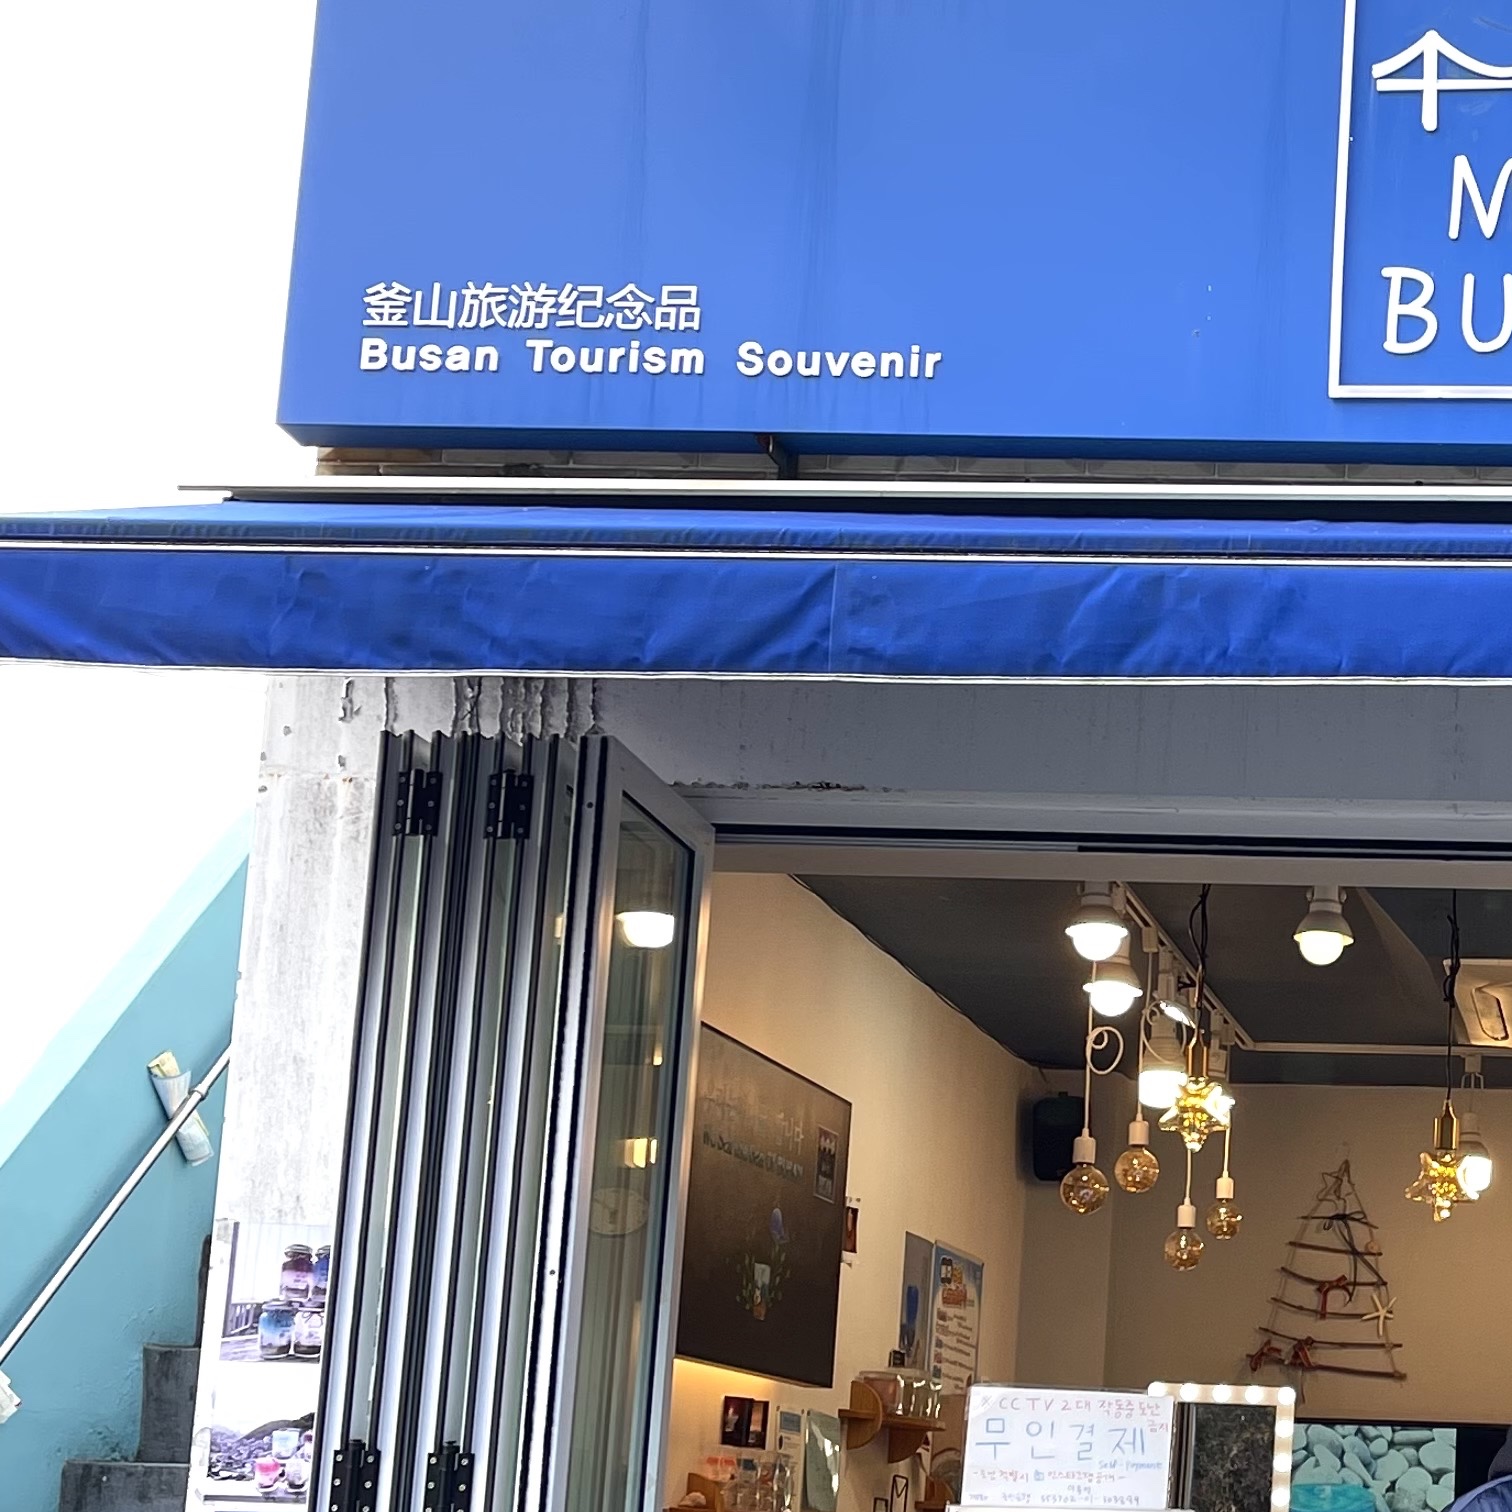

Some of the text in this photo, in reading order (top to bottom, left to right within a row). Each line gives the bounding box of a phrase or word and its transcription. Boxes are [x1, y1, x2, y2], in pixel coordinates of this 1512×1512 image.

[362, 280, 702, 331] 釜山旅游纪念品
[359, 337, 942, 380] Busan Tourism Souvenir
[974, 1417, 1147, 1462] 무인결제
